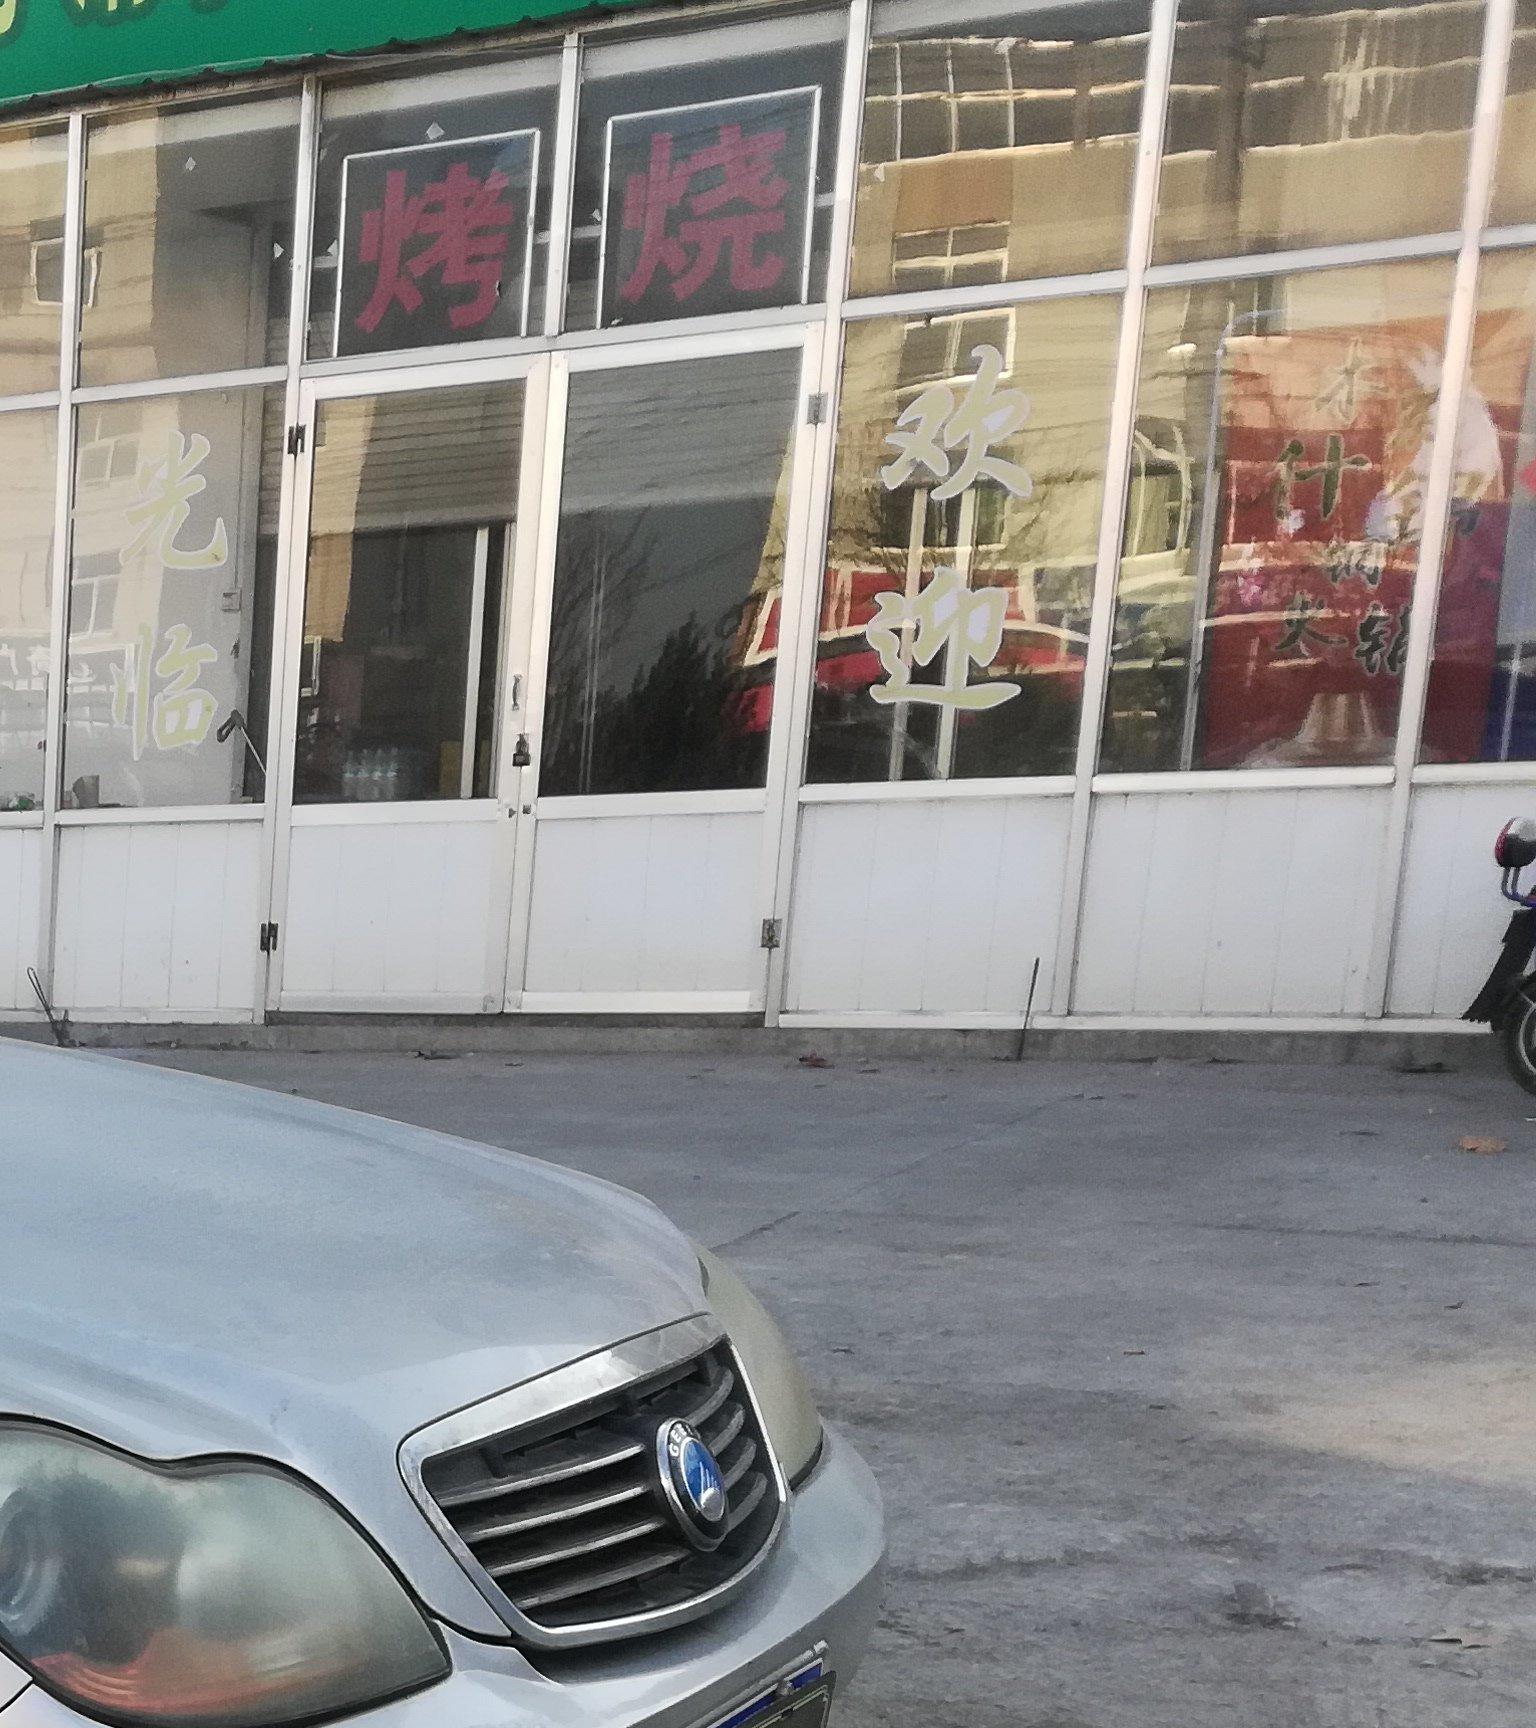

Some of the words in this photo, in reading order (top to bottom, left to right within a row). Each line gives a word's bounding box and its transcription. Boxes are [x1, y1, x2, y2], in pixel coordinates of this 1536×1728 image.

[356, 161, 516, 333] 烤
[620, 124, 791, 304] 烧
[110, 430, 228, 761] 光临
[866, 344, 1033, 710] 欢迎
